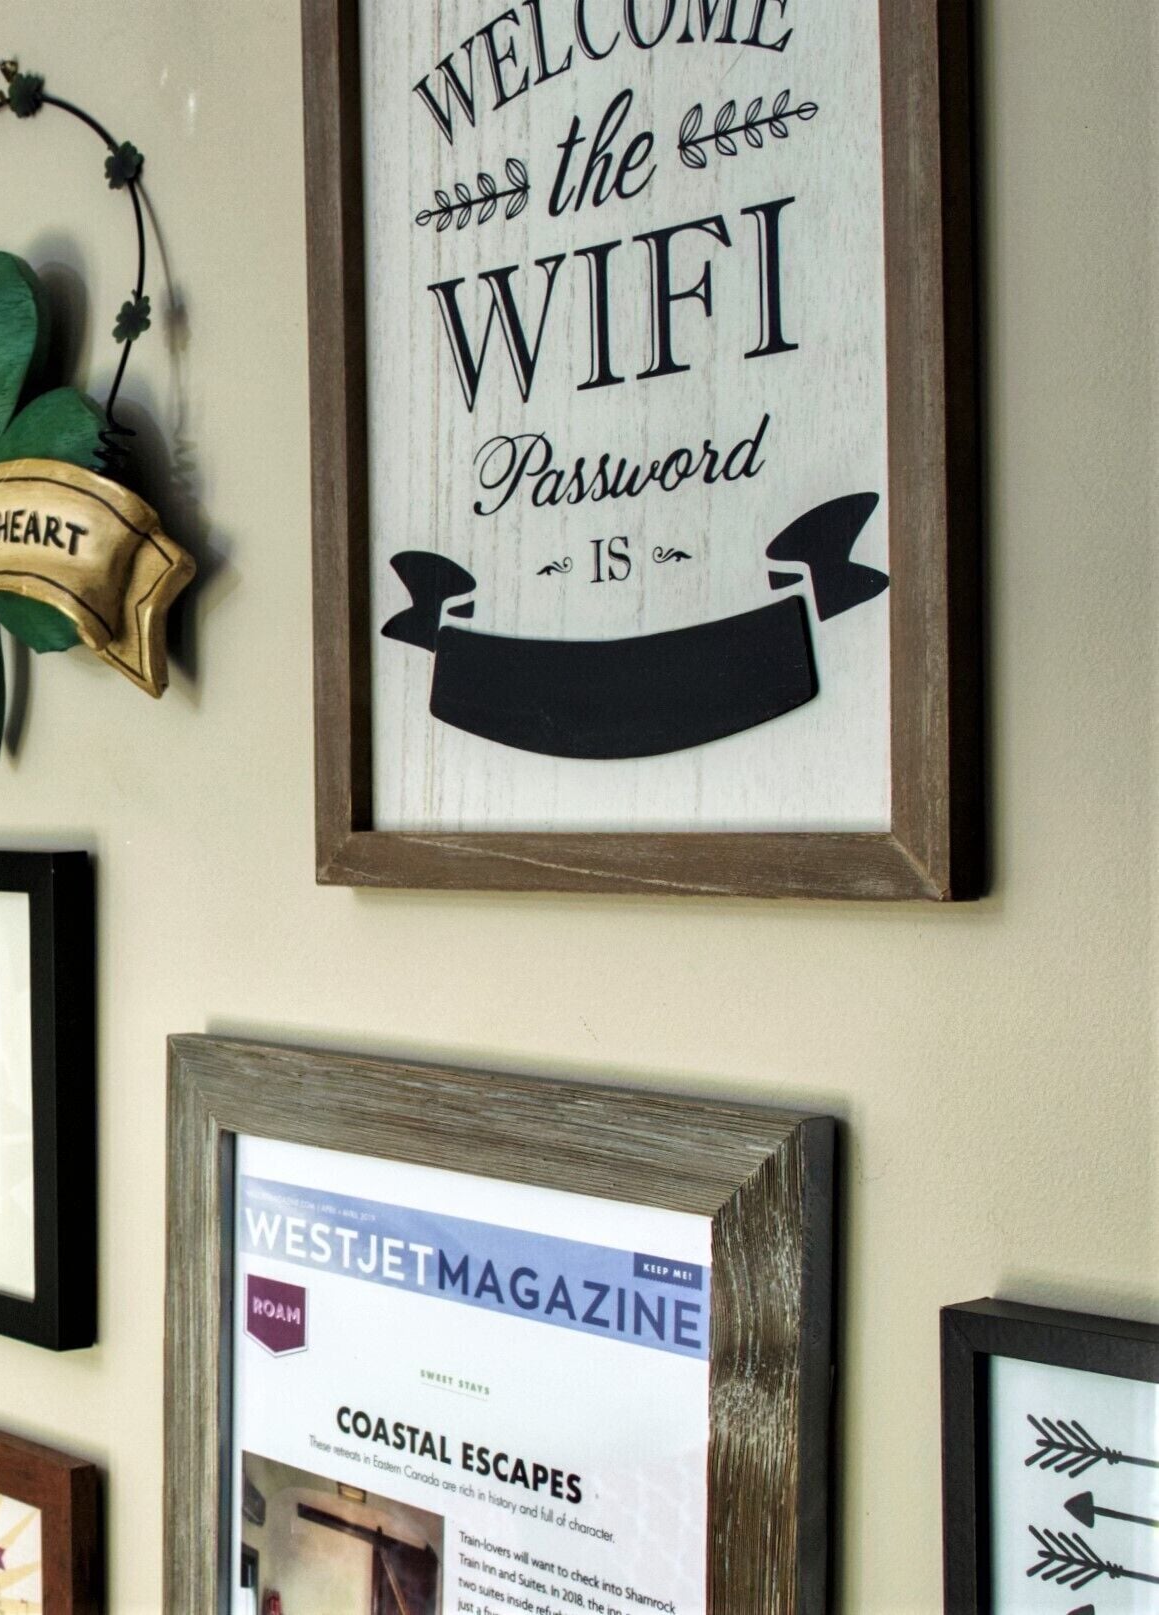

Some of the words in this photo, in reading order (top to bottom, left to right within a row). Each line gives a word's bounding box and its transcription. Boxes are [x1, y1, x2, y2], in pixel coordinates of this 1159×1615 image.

[548, 89, 657, 216] the
[427, 197, 799, 413] WIFI
[473, 413, 770, 516] Password
[590, 536, 632, 583] IS
[643, 1263, 668, 1275] KEEP
[673, 1269, 692, 1281] ME!
[252, 1295, 301, 1325] ROAM
[420, 1369, 453, 1385] SWEET
[458, 1379, 489, 1396] STAYS
[337, 1406, 452, 1465] COASTAL
[462, 1442, 582, 1504] ESCAPES
[309, 1434, 331, 1453] These
[333, 1445, 361, 1462] retreats
[363, 1452, 371, 1465] in
[373, 1454, 402, 1475] Eastern
[404, 1465, 439, 1487] Canada
[442, 1480, 457, 1493] are
[459, 1484, 475, 1498] rich
[478, 1490, 486, 1502] in
[488, 1491, 517, 1515] history
[520, 1503, 538, 1519] and
[541, 1506, 553, 1523] full
[556, 1512, 567, 1527] of
[569, 1517, 615, 1544] character.
[458, 1577, 477, 1592] two
[479, 1584, 504, 1602] suites
[507, 1594, 534, 1612] inside
[459, 1530, 511, 1559] Train-lovers
[513, 1551, 529, 1565] will
[531, 1558, 555, 1574] want
[557, 1565, 568, 1578] to
[571, 1569, 599, 1588] check
[602, 1579, 623, 1596] into
[625, 1586, 676, 1615] Shamrock
[459, 1552, 480, 1570] Train
[482, 1560, 497, 1576] Inn
[498, 1568, 516, 1583] and
[518, 1573, 548, 1595] Suites.
[551, 1584, 560, 1598] In
[588, 1598, 604, 1614] the
[458, 1596, 474, 1612] just
